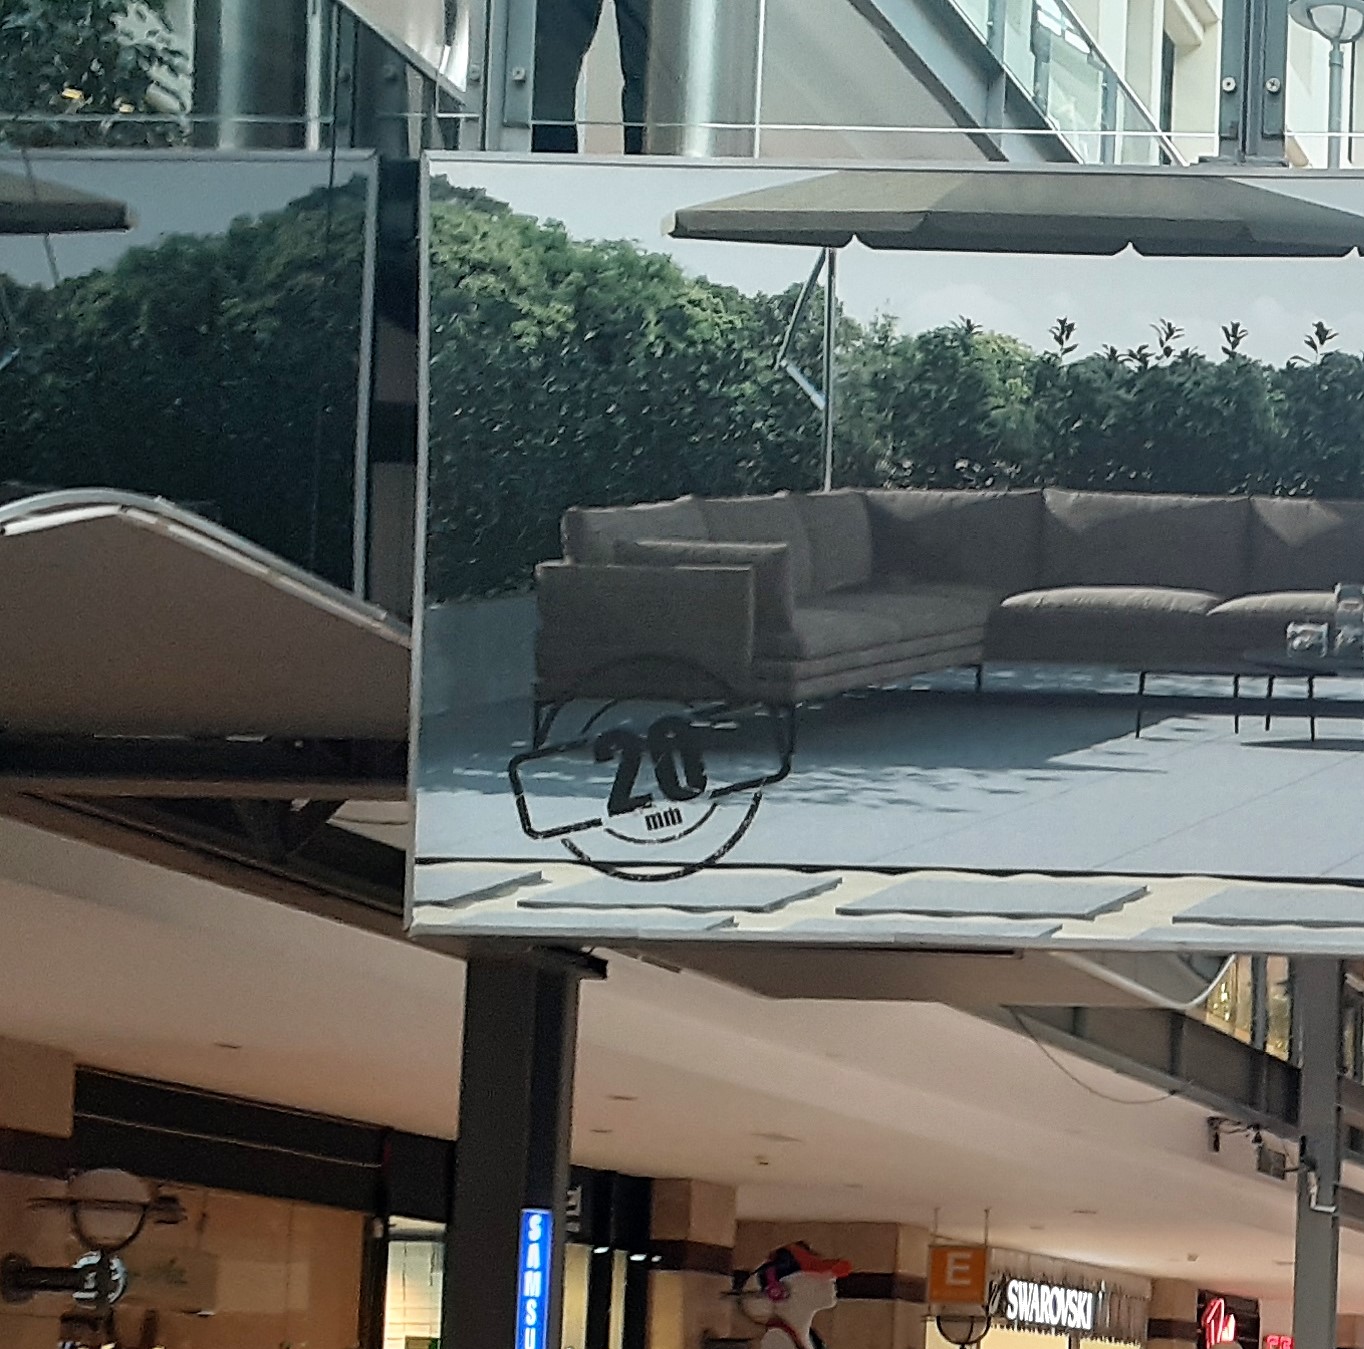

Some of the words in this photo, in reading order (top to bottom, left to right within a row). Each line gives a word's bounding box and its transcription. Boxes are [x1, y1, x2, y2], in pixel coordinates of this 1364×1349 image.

[594, 714, 708, 818] 20
[645, 807, 683, 831] mm
[945, 1252, 972, 1287] E
[1005, 1278, 1093, 1331] SWAROVSKI
